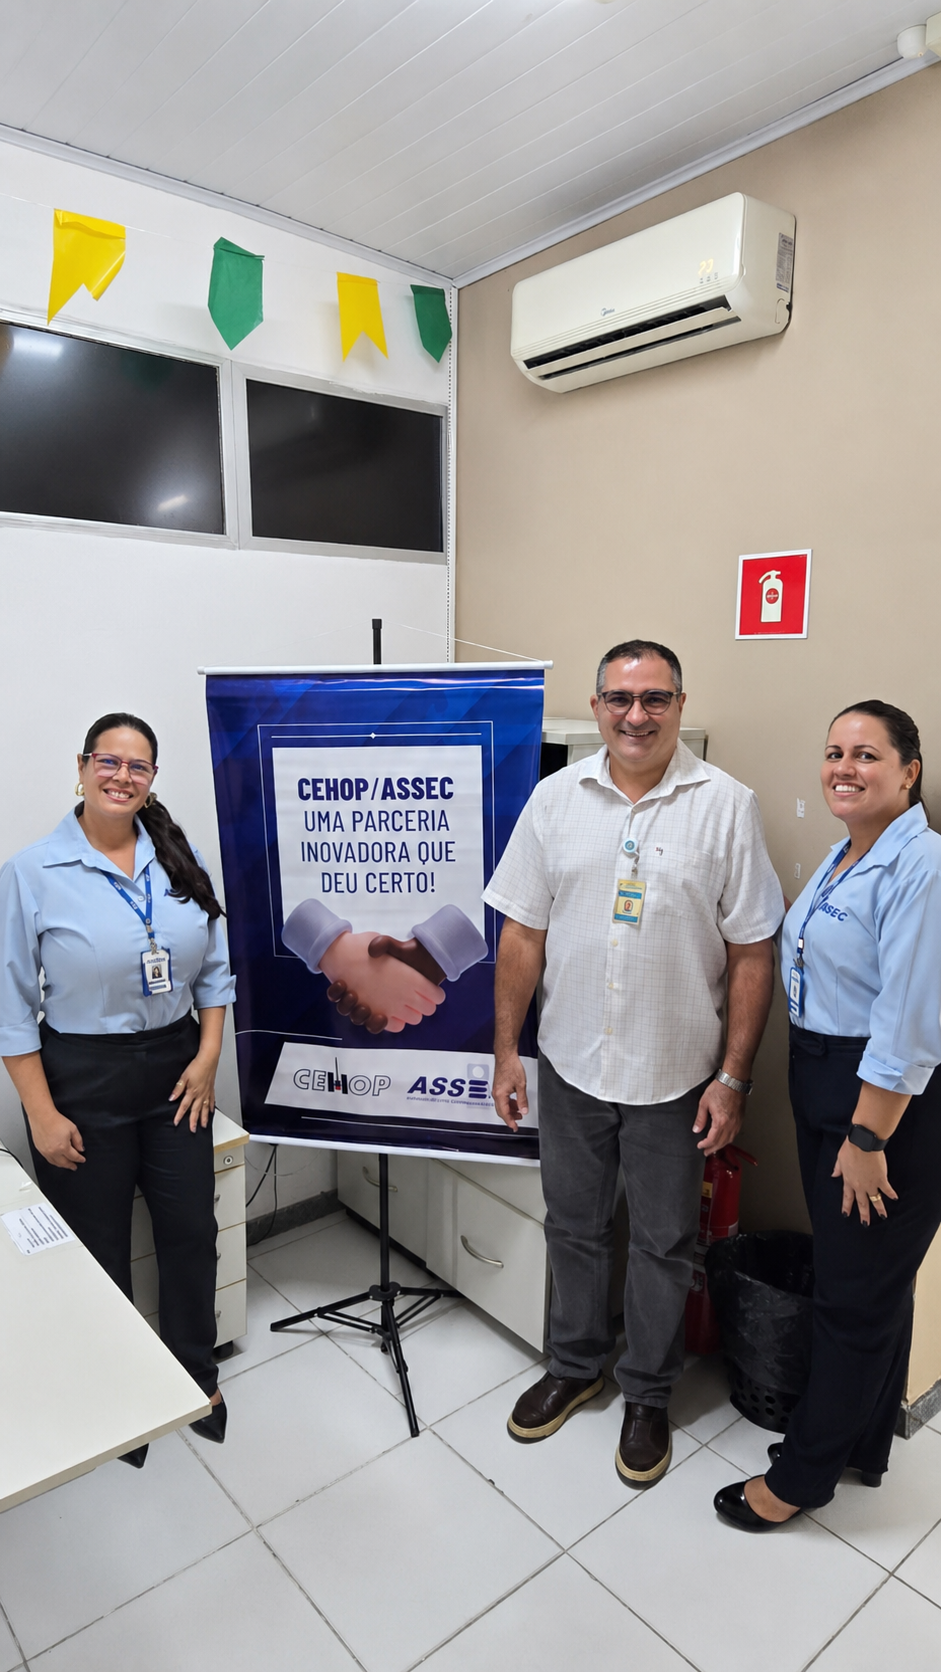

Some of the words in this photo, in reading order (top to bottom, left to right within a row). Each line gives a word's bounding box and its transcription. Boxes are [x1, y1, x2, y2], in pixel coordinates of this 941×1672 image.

[297, 776, 454, 801] CEHOP/ASSEC
[304, 811, 345, 832] UMA
[352, 809, 450, 832] PARCERIA
[301, 841, 411, 863] INOVADORA
[418, 840, 456, 865] QUE
[321, 872, 358, 893] DEU
[365, 871, 436, 893] CERTO!
[293, 1066, 392, 1097] CEHOP
[406, 1075, 493, 1099] ASSE
